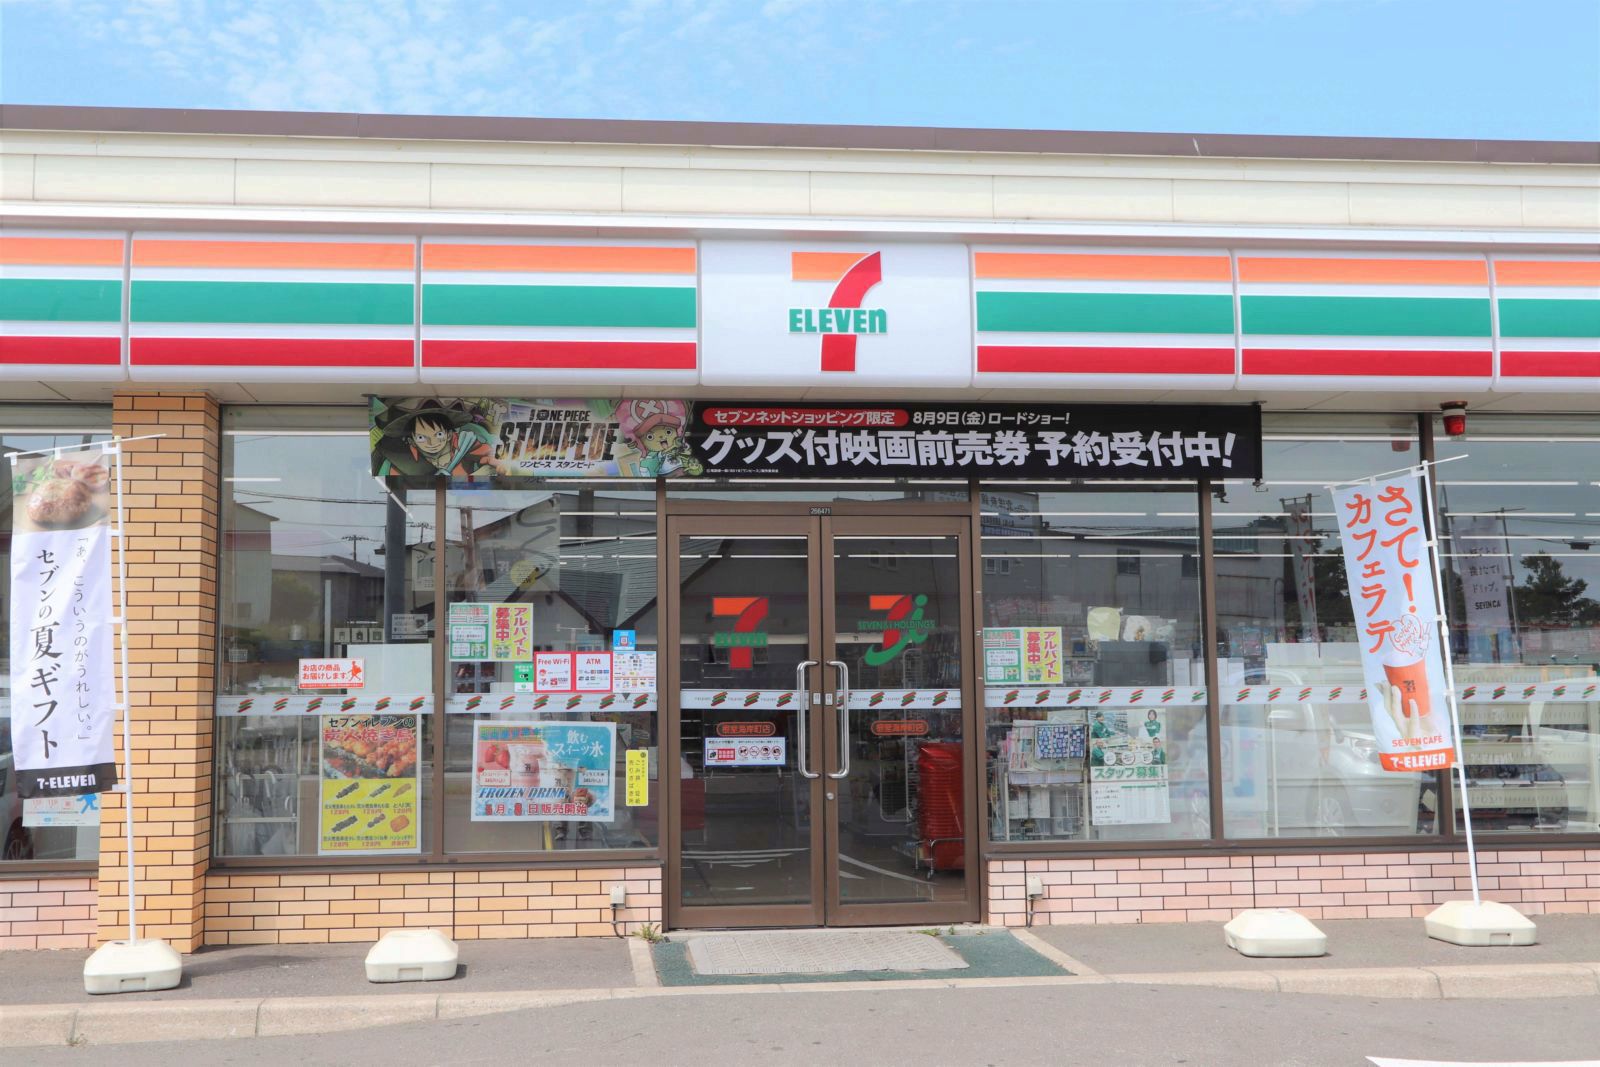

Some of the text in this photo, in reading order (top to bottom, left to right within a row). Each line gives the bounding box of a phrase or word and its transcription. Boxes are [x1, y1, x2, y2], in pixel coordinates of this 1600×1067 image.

[564, 410, 591, 421] PIECE
[715, 410, 895, 425] セブンネットショッピング限定
[495, 421, 620, 463] STAMPEDE
[701, 428, 1030, 466] グッズ付映画前売券
[1346, 494, 1395, 654] カフェラテ
[496, 607, 510, 642] 募集中
[514, 607, 529, 656] アルバイト
[30, 549, 64, 759] セブンの夏ギフト
[1027, 631, 1040, 664] 募集中
[1044, 631, 1057, 679] アルバイト
[303, 664, 340, 672] お店の商品
[1392, 738, 1421, 747] SEVEN
[479, 787, 567, 799] FROZEN DRINK
